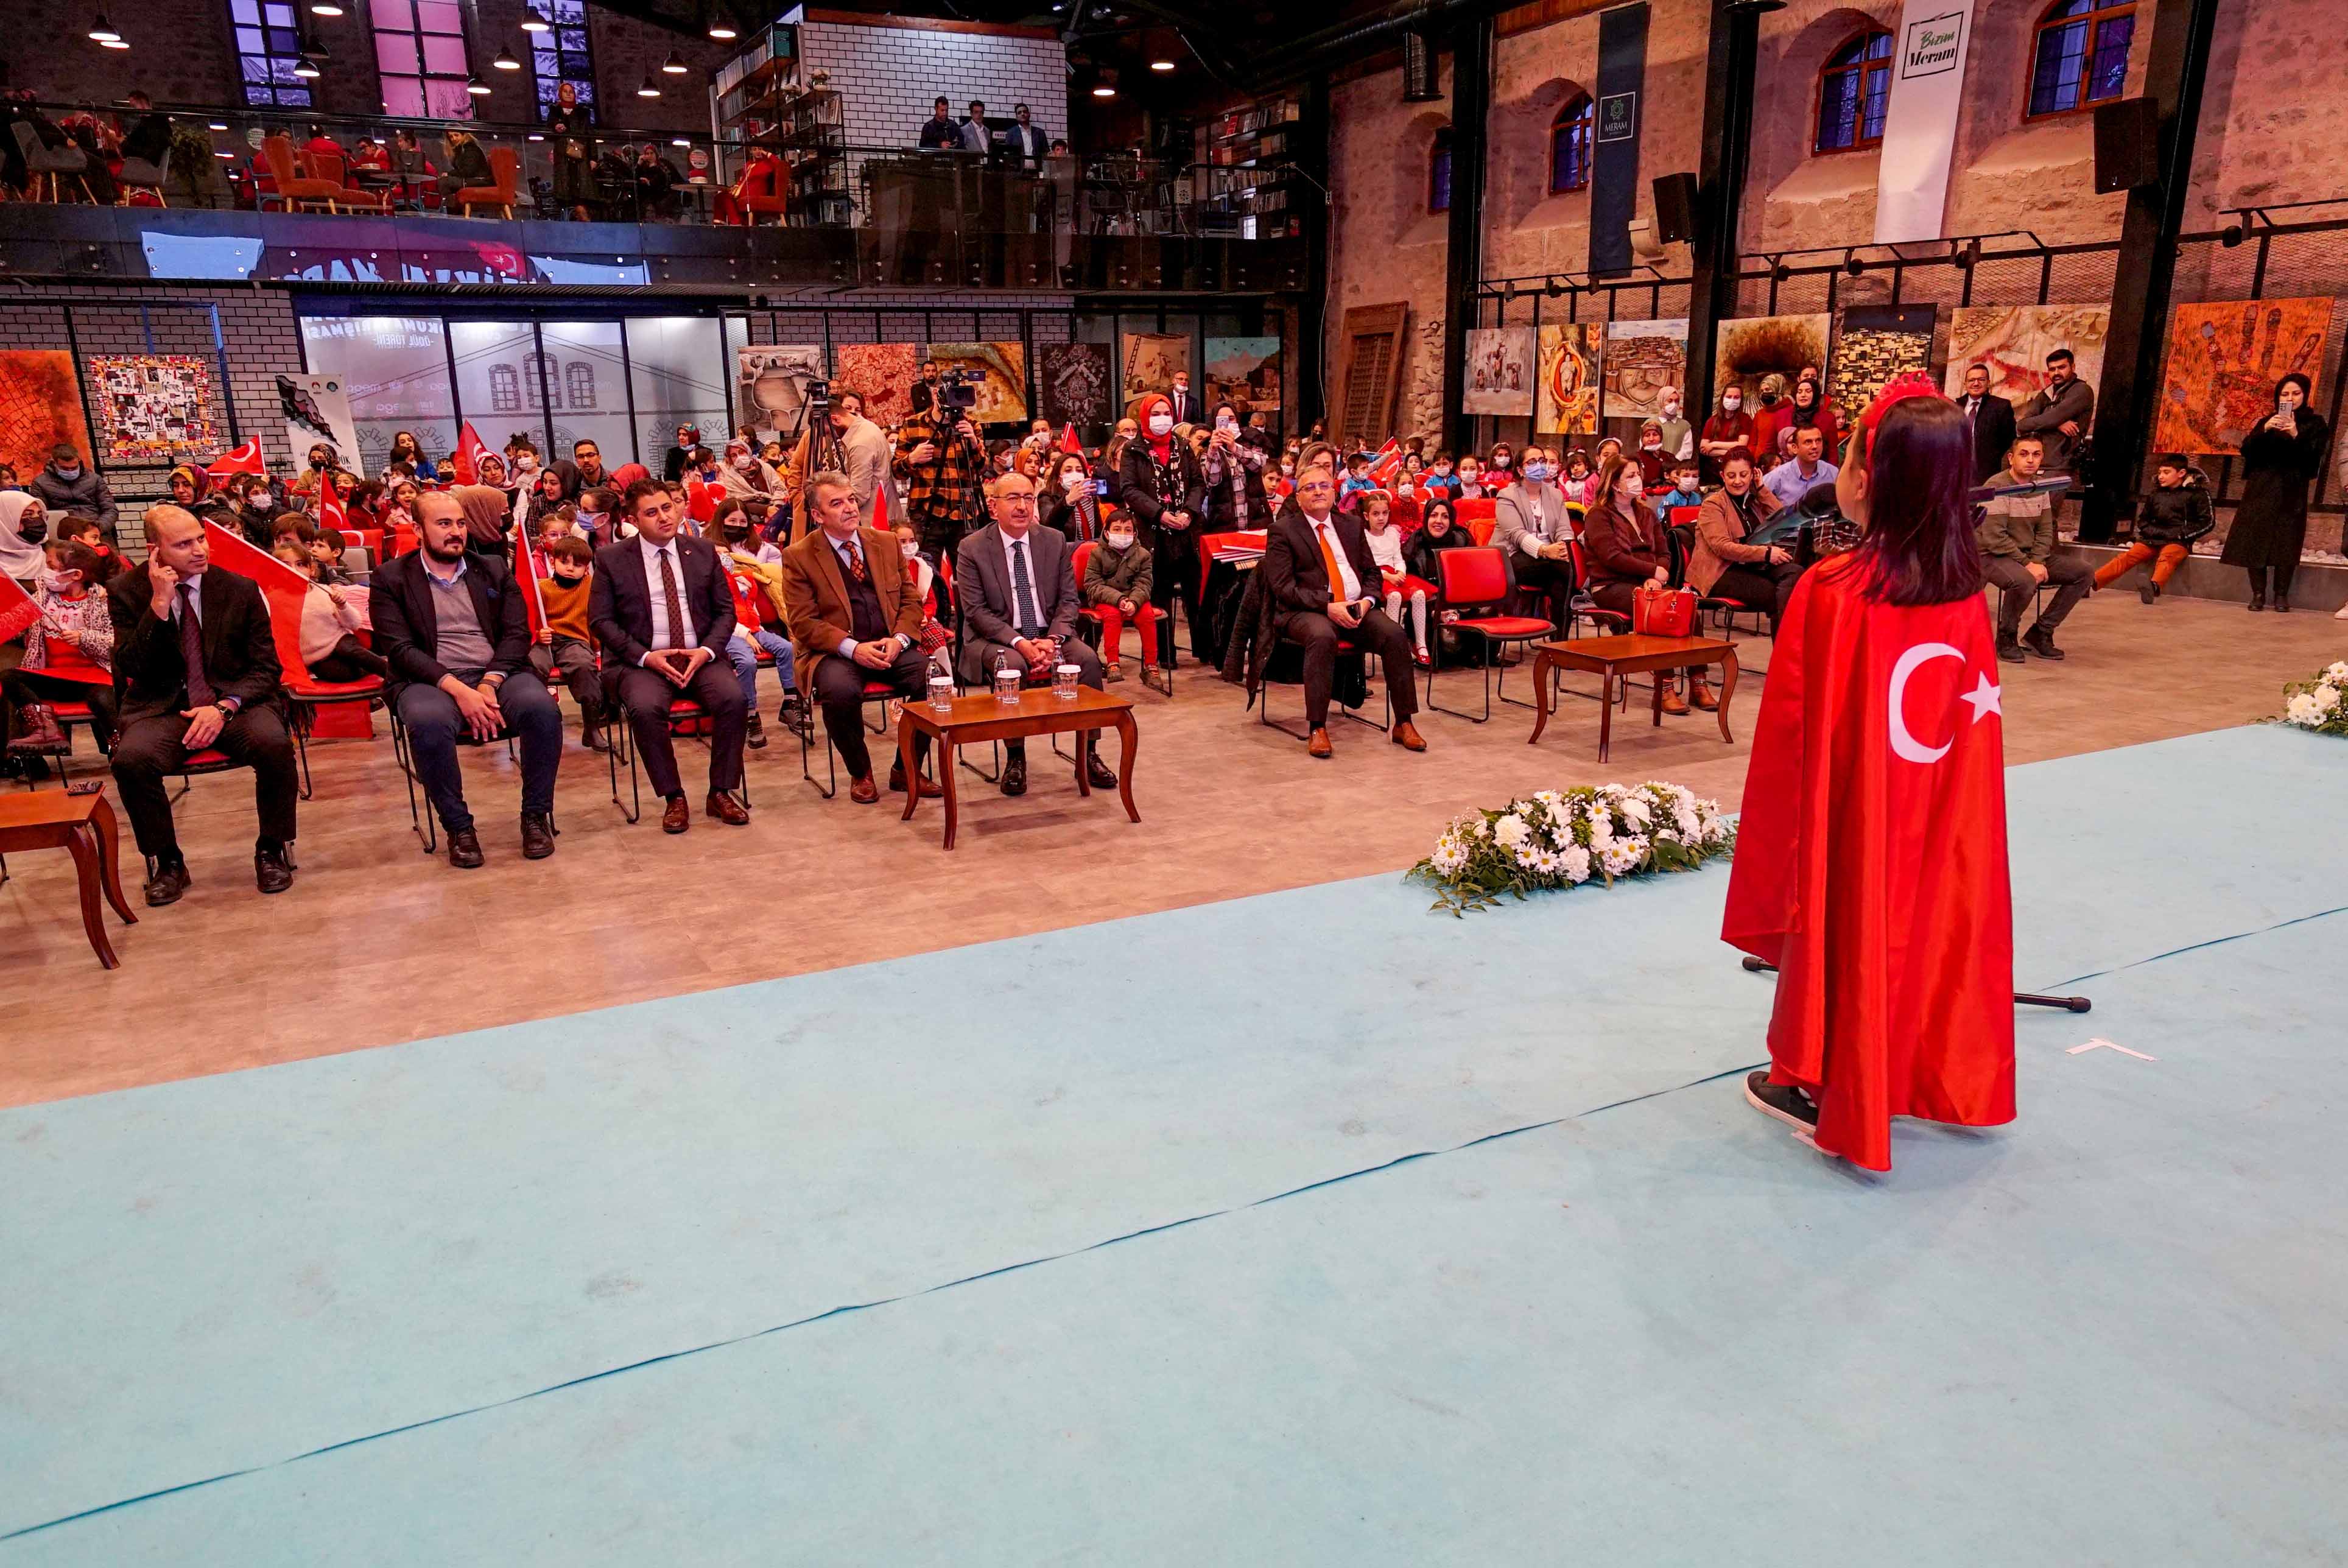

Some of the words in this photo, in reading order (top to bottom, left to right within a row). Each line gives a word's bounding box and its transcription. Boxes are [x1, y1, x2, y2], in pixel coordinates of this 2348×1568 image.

[1920, 30, 1955, 49] Bizim
[1907, 47, 1956, 67] Meram
[1605, 121, 1628, 132] MERAM
